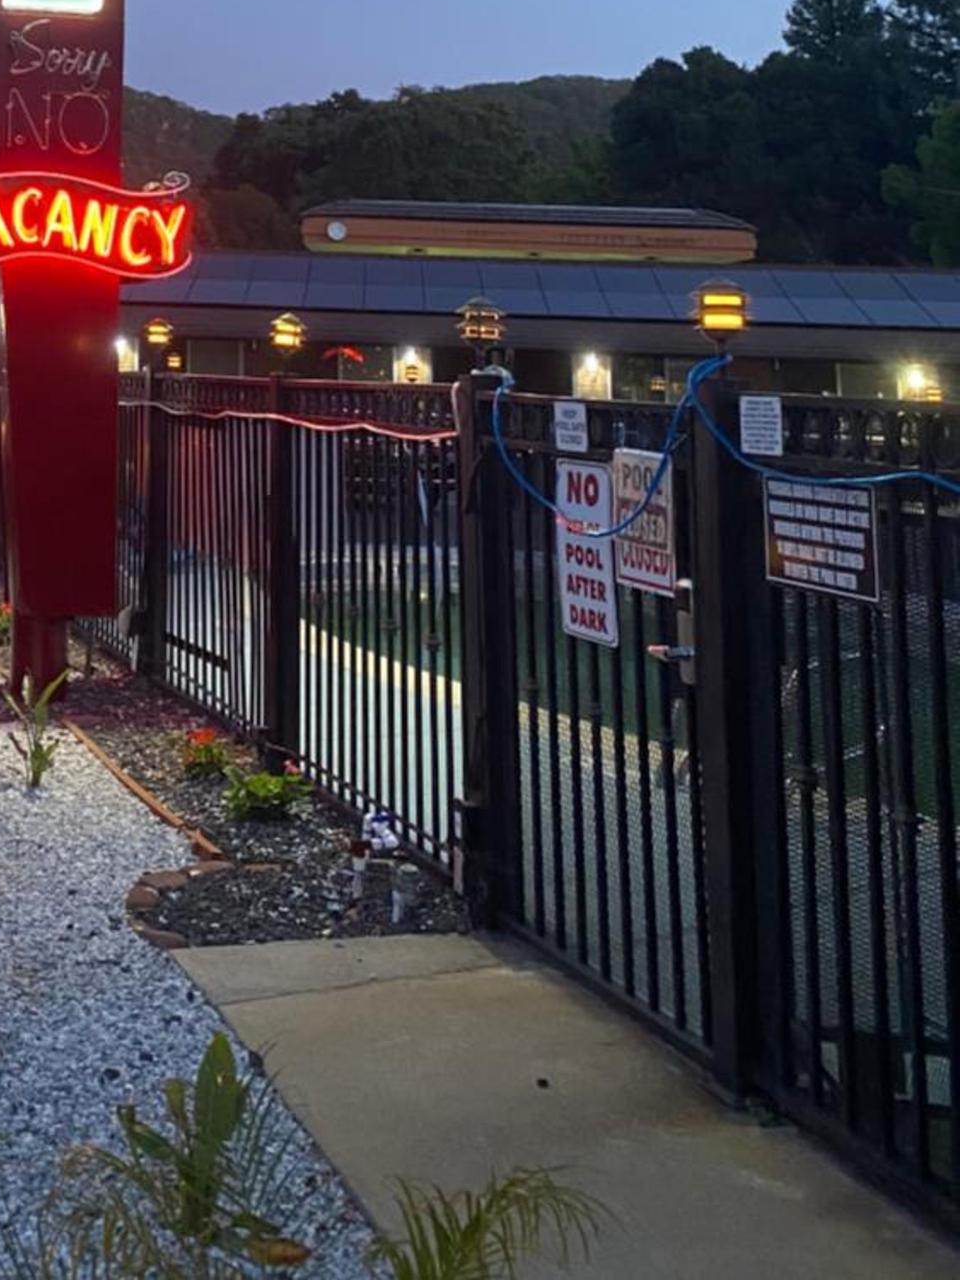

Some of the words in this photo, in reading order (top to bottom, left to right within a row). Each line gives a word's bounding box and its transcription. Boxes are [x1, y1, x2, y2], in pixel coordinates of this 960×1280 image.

[9, 18, 111, 91] Sorry
[5, 87, 110, 155] NO
[567, 471, 599, 507] NO
[565, 543, 604, 571] POOL
[567, 573, 607, 602] AFTER
[569, 604, 609, 634] DARK
